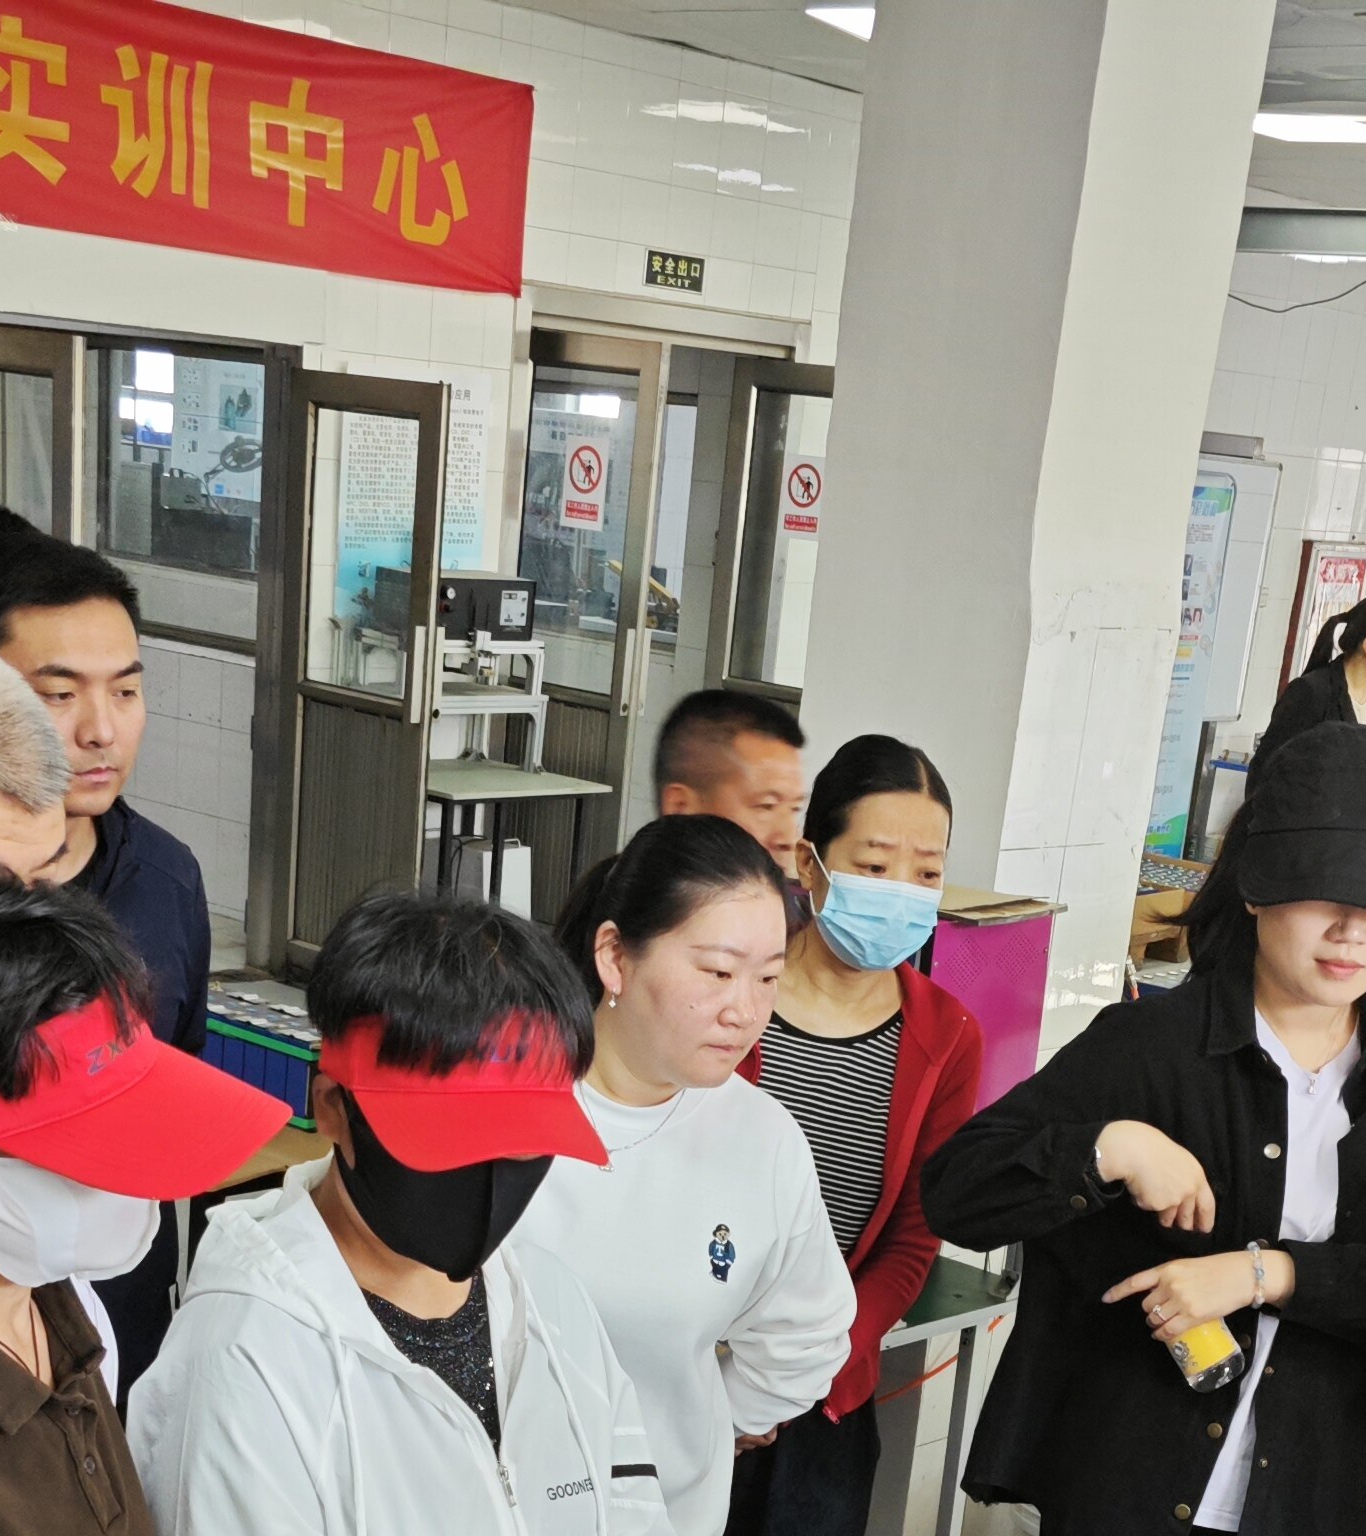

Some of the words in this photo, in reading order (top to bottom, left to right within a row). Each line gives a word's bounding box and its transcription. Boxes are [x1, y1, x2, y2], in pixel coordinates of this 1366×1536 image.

[651, 255, 700, 278] 安全出口
[657, 275, 691, 287] EXIT
